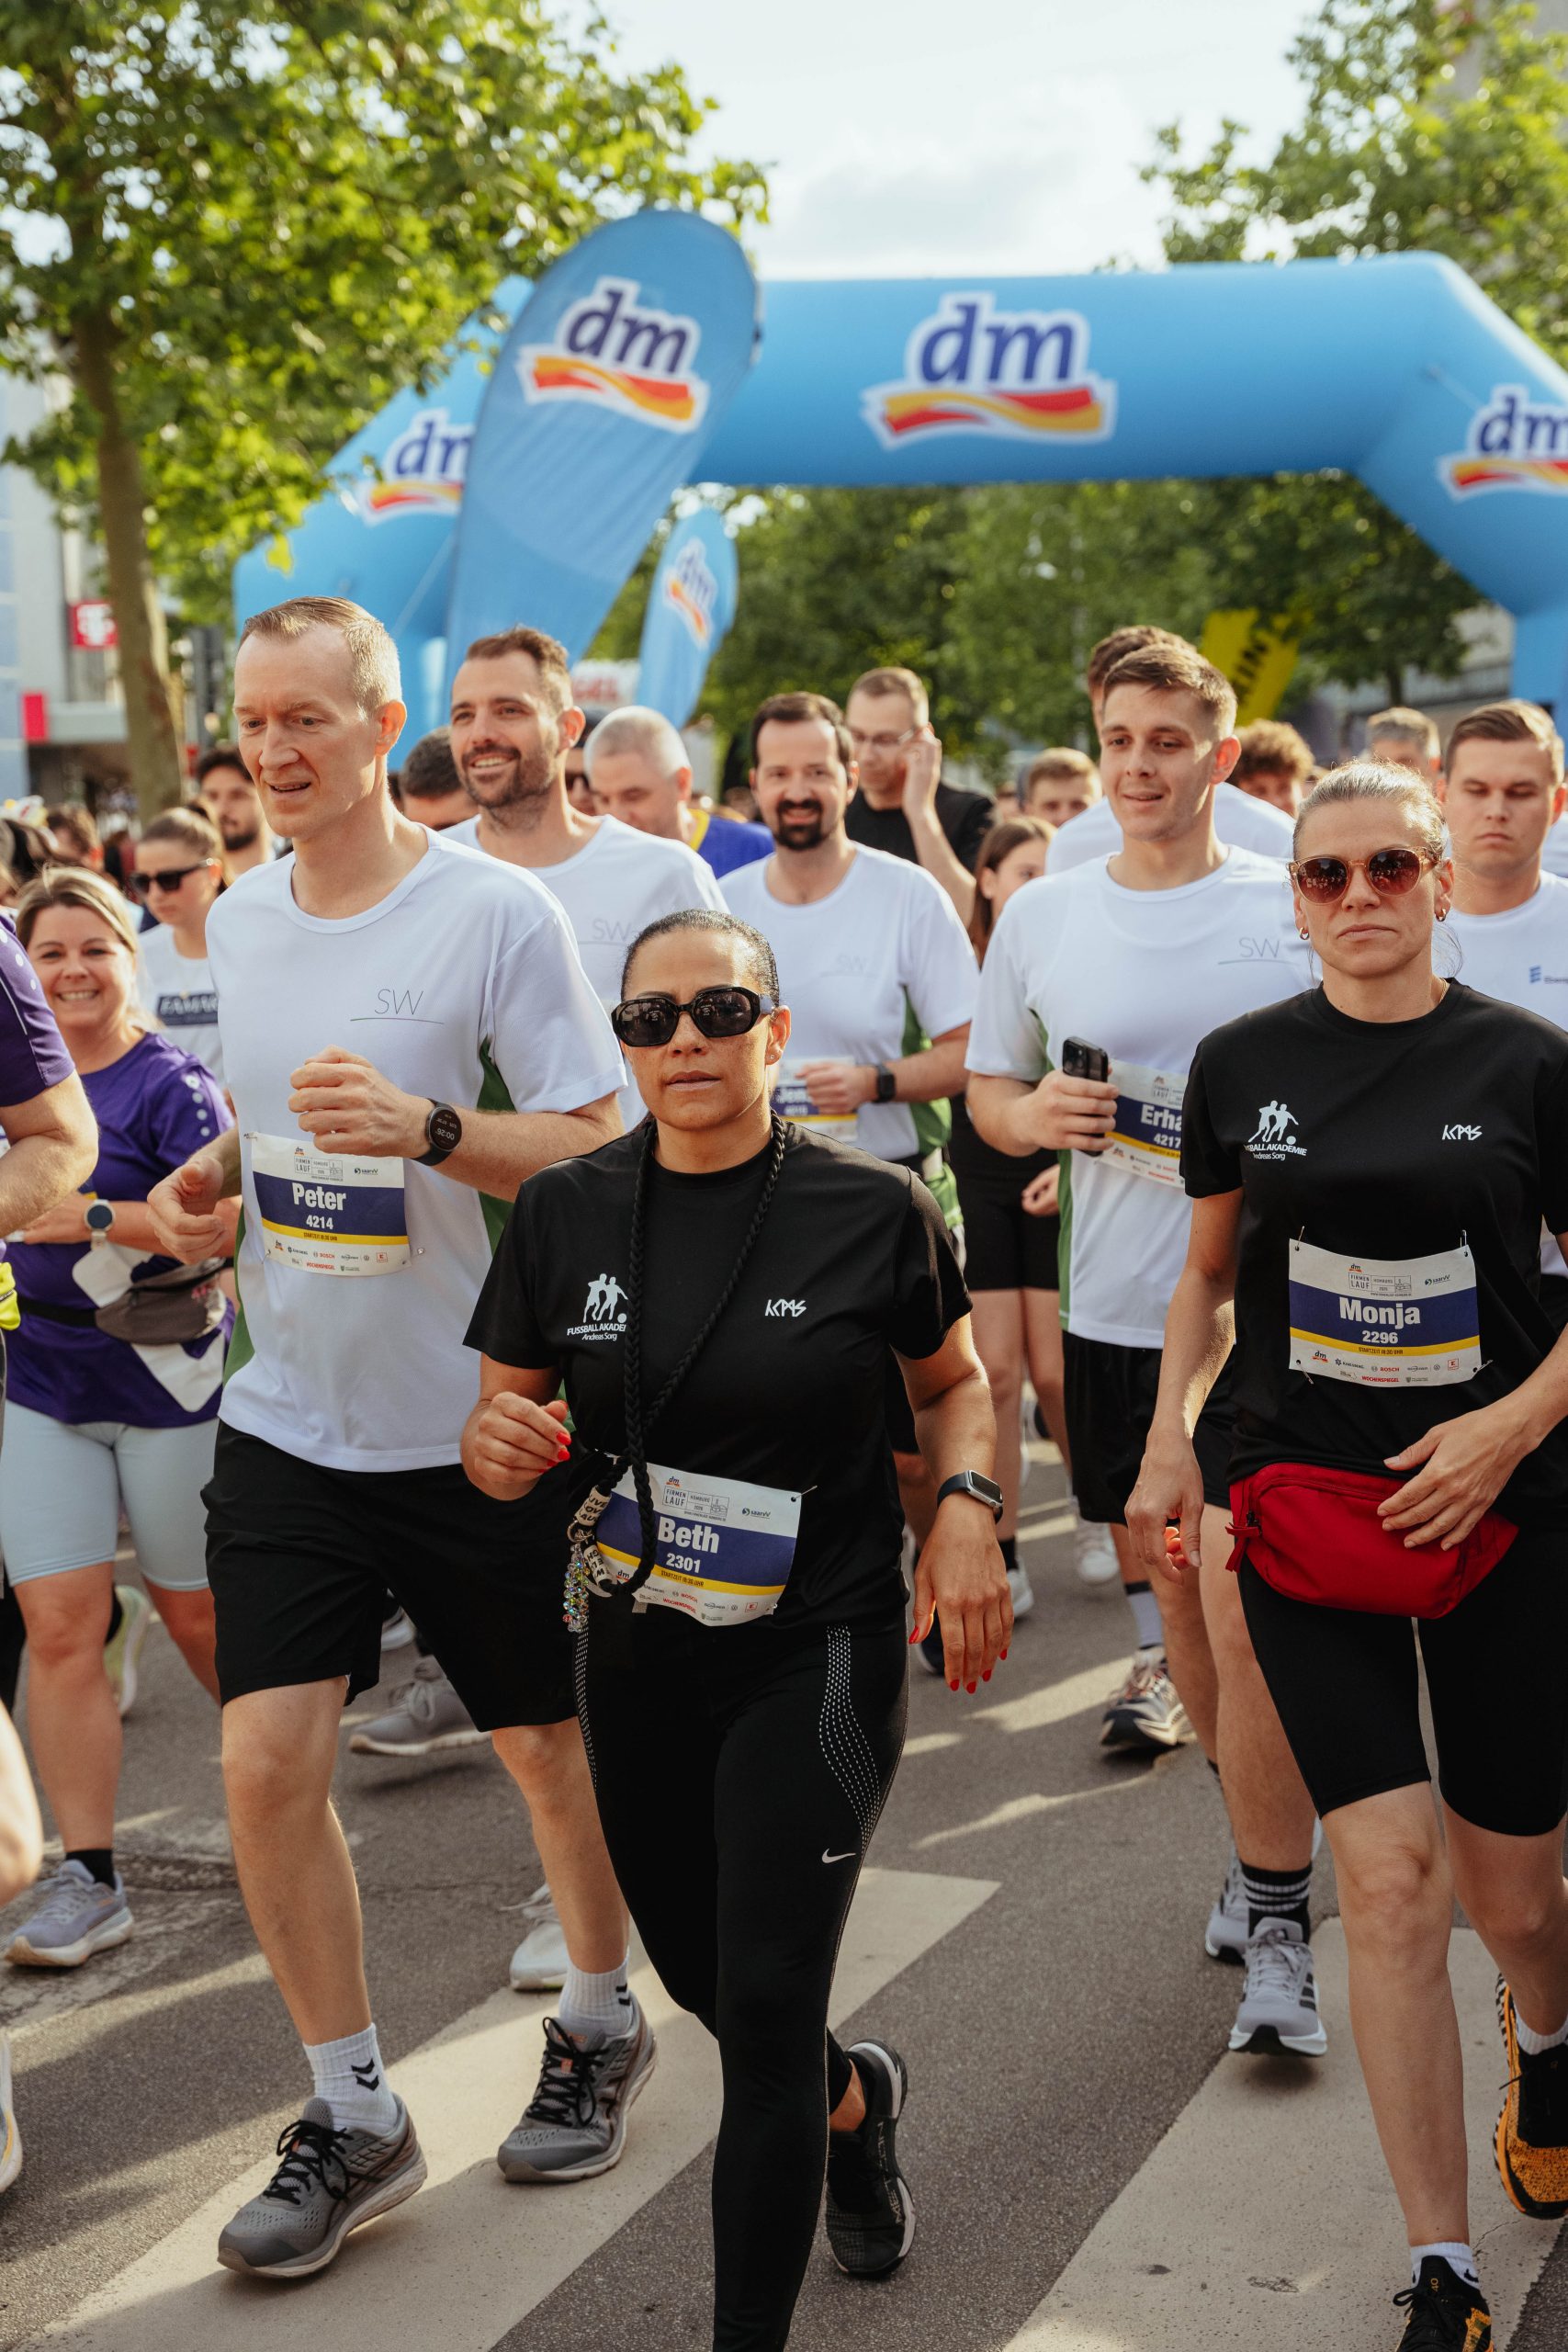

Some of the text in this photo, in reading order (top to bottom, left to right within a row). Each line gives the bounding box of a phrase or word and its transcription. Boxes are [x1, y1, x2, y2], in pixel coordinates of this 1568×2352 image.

[566, 288, 690, 374] dm
[921, 302, 1075, 382] dm
[1238, 936, 1280, 957] SW
[374, 988, 424, 1015] SW
[1154, 1133, 1181, 1148] 4217
[1267, 1143, 1307, 1157] AKADEMIE
[1272, 1152, 1286, 1161] Sorg
[296, 1164, 310, 1172] LAUF
[291, 1182, 346, 1211] Peter
[306, 1214, 333, 1230] 4214
[1350, 1273, 1370, 1282] FIRMEN
[1350, 1280, 1370, 1289] LAUF
[1338, 1296, 1421, 1329] Monja
[567, 1323, 626, 1336] FUSSBALL AKADE
[604, 1332, 617, 1341] Sorg
[1361, 1329, 1399, 1344] 2296
[1314, 1351, 1326, 1360] dm
[1359, 1346, 1381, 1355] STARTZEIT
[668, 1476, 680, 1485] dm
[666, 1487, 687, 1498] FIRMEN
[664, 1495, 685, 1508] LAUF
[657, 1515, 720, 1555] Beth
[666, 1552, 701, 1574] 2301
[617, 1569, 630, 1579] dm
[660, 1570, 682, 1582] STARTZEIT
[694, 1578, 705, 1588] UHR
[681, 1592, 698, 1604] BOSCH
[662, 1597, 697, 1614] WOCHENSPIEGEL
